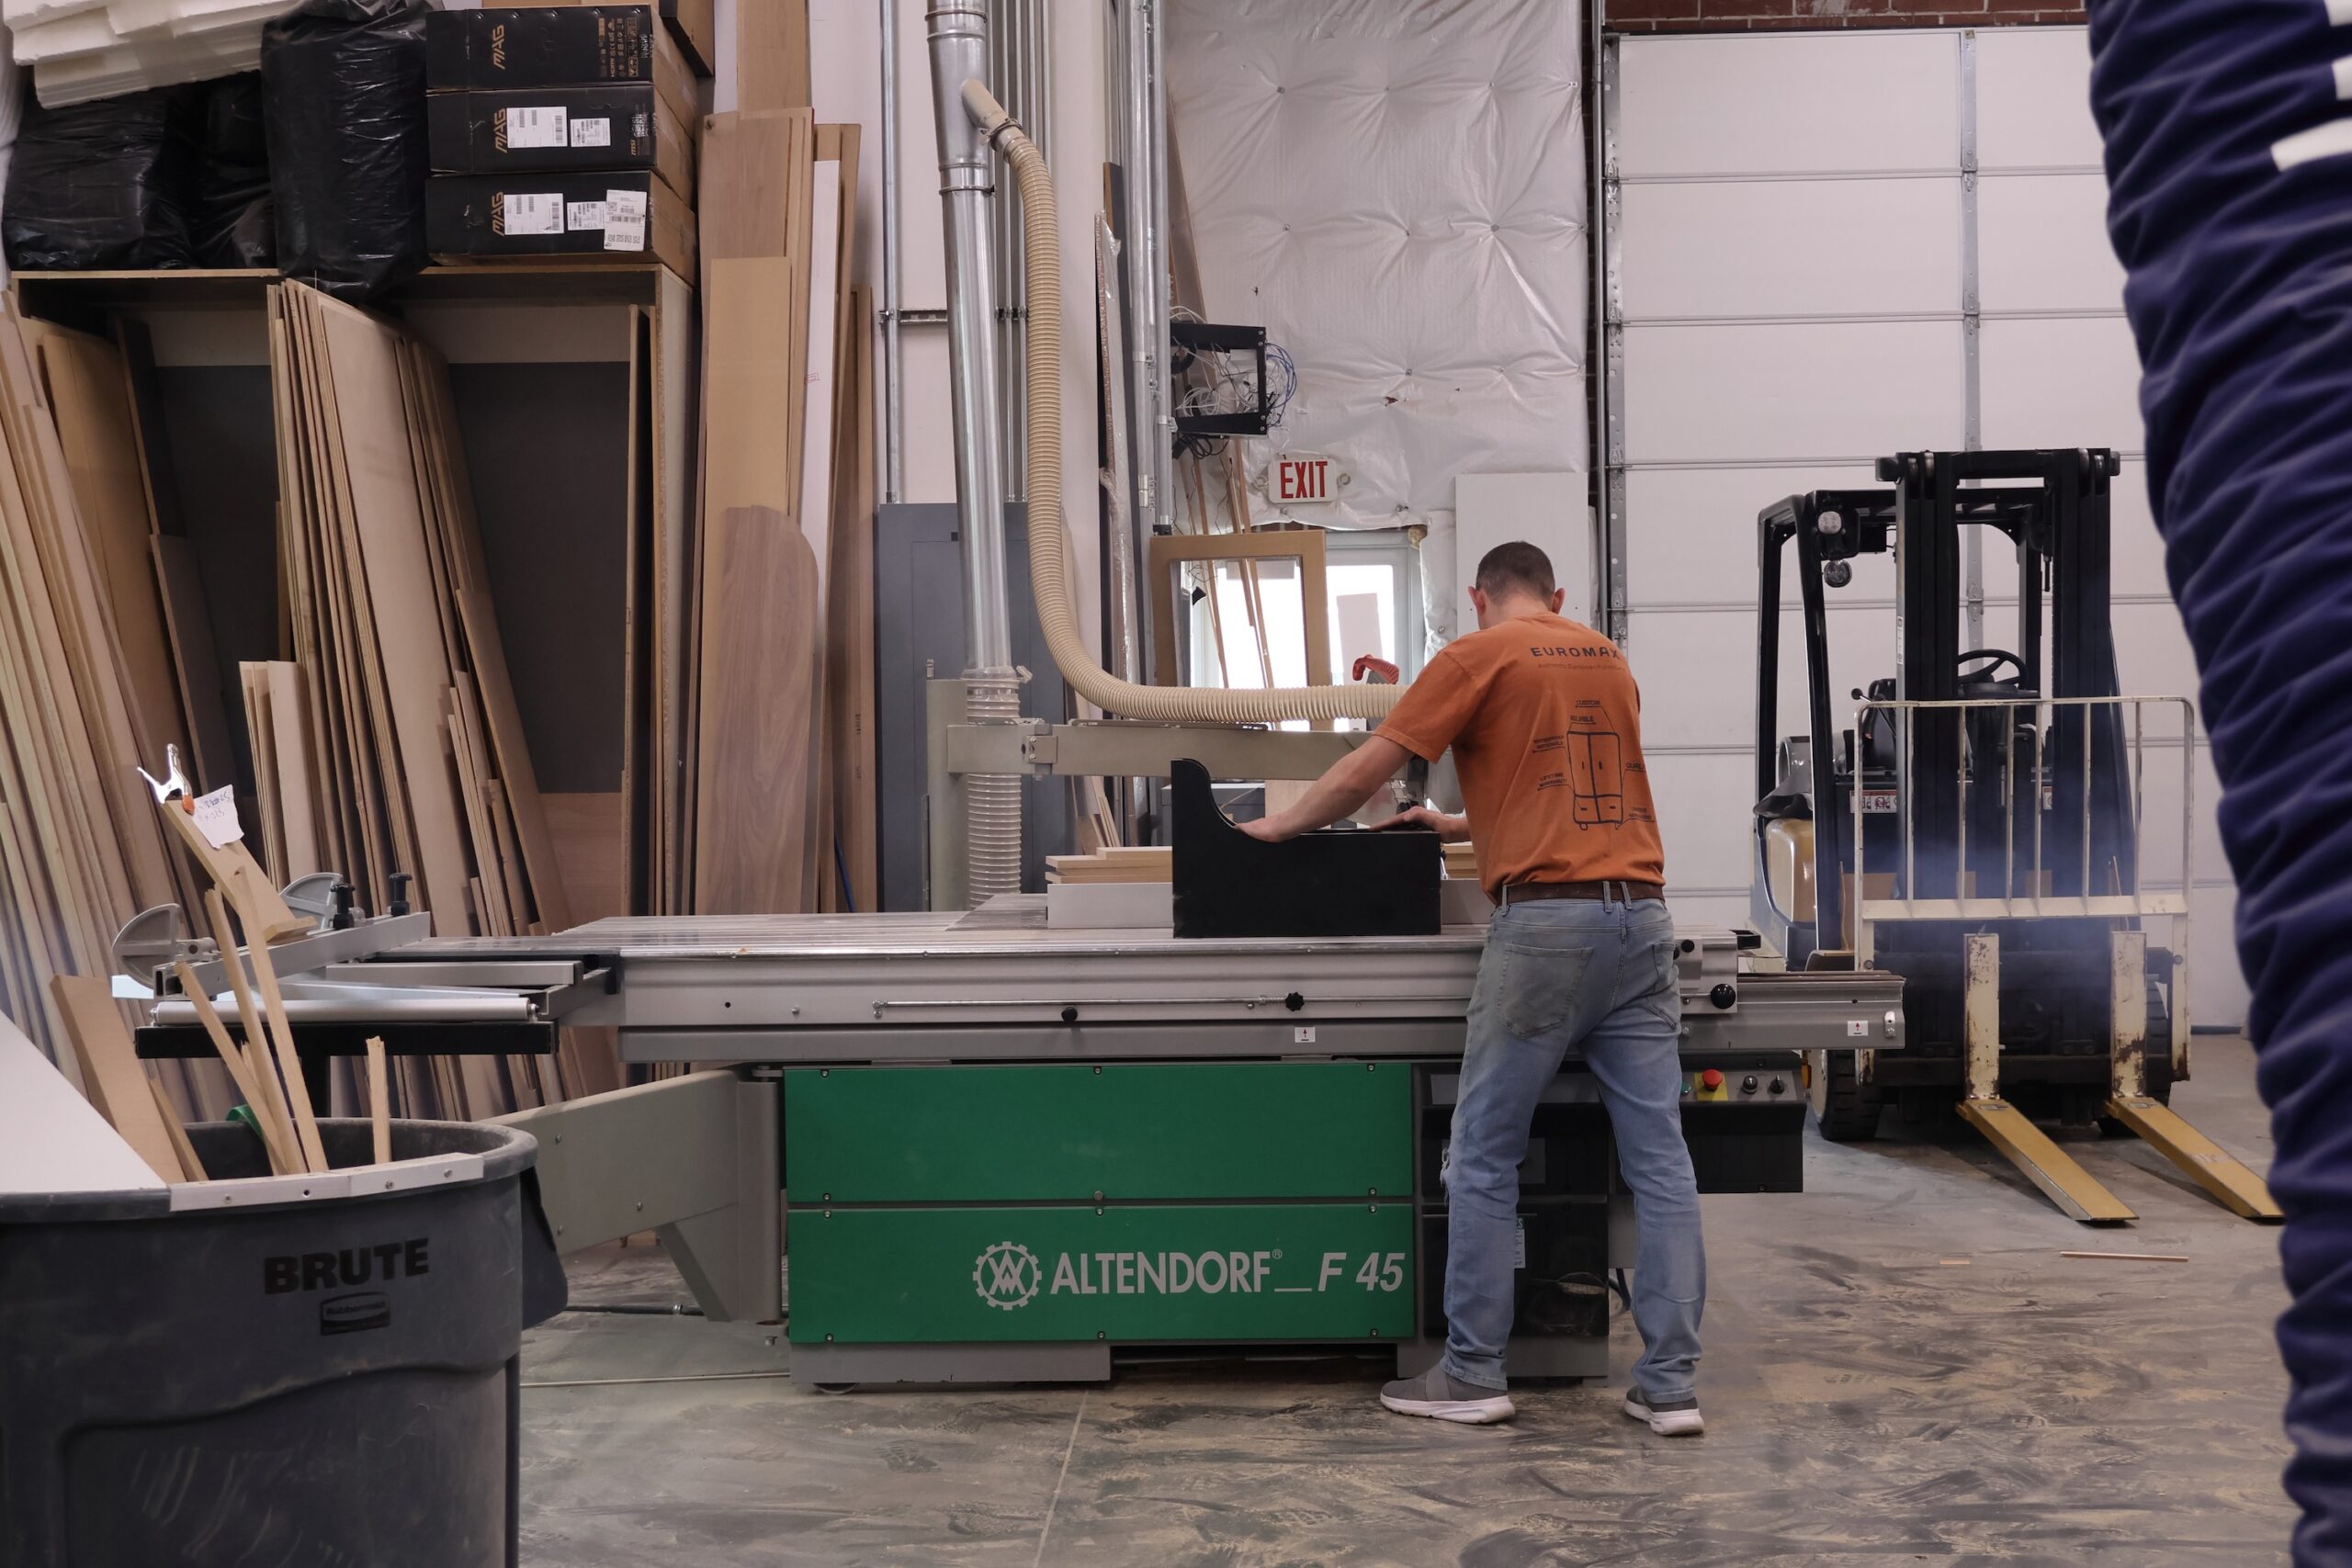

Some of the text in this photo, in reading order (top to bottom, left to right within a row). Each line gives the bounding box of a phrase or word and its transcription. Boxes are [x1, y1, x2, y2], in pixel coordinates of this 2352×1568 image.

[492, 24, 505, 70] MAG
[494, 107, 507, 153] MAG
[492, 191, 505, 236] MAG
[1280, 461, 1328, 499] EXIT
[1530, 646, 1621, 660] EUROMAX
[264, 1237, 429, 1294] BRUTE
[1355, 1252, 1405, 1292] 45
